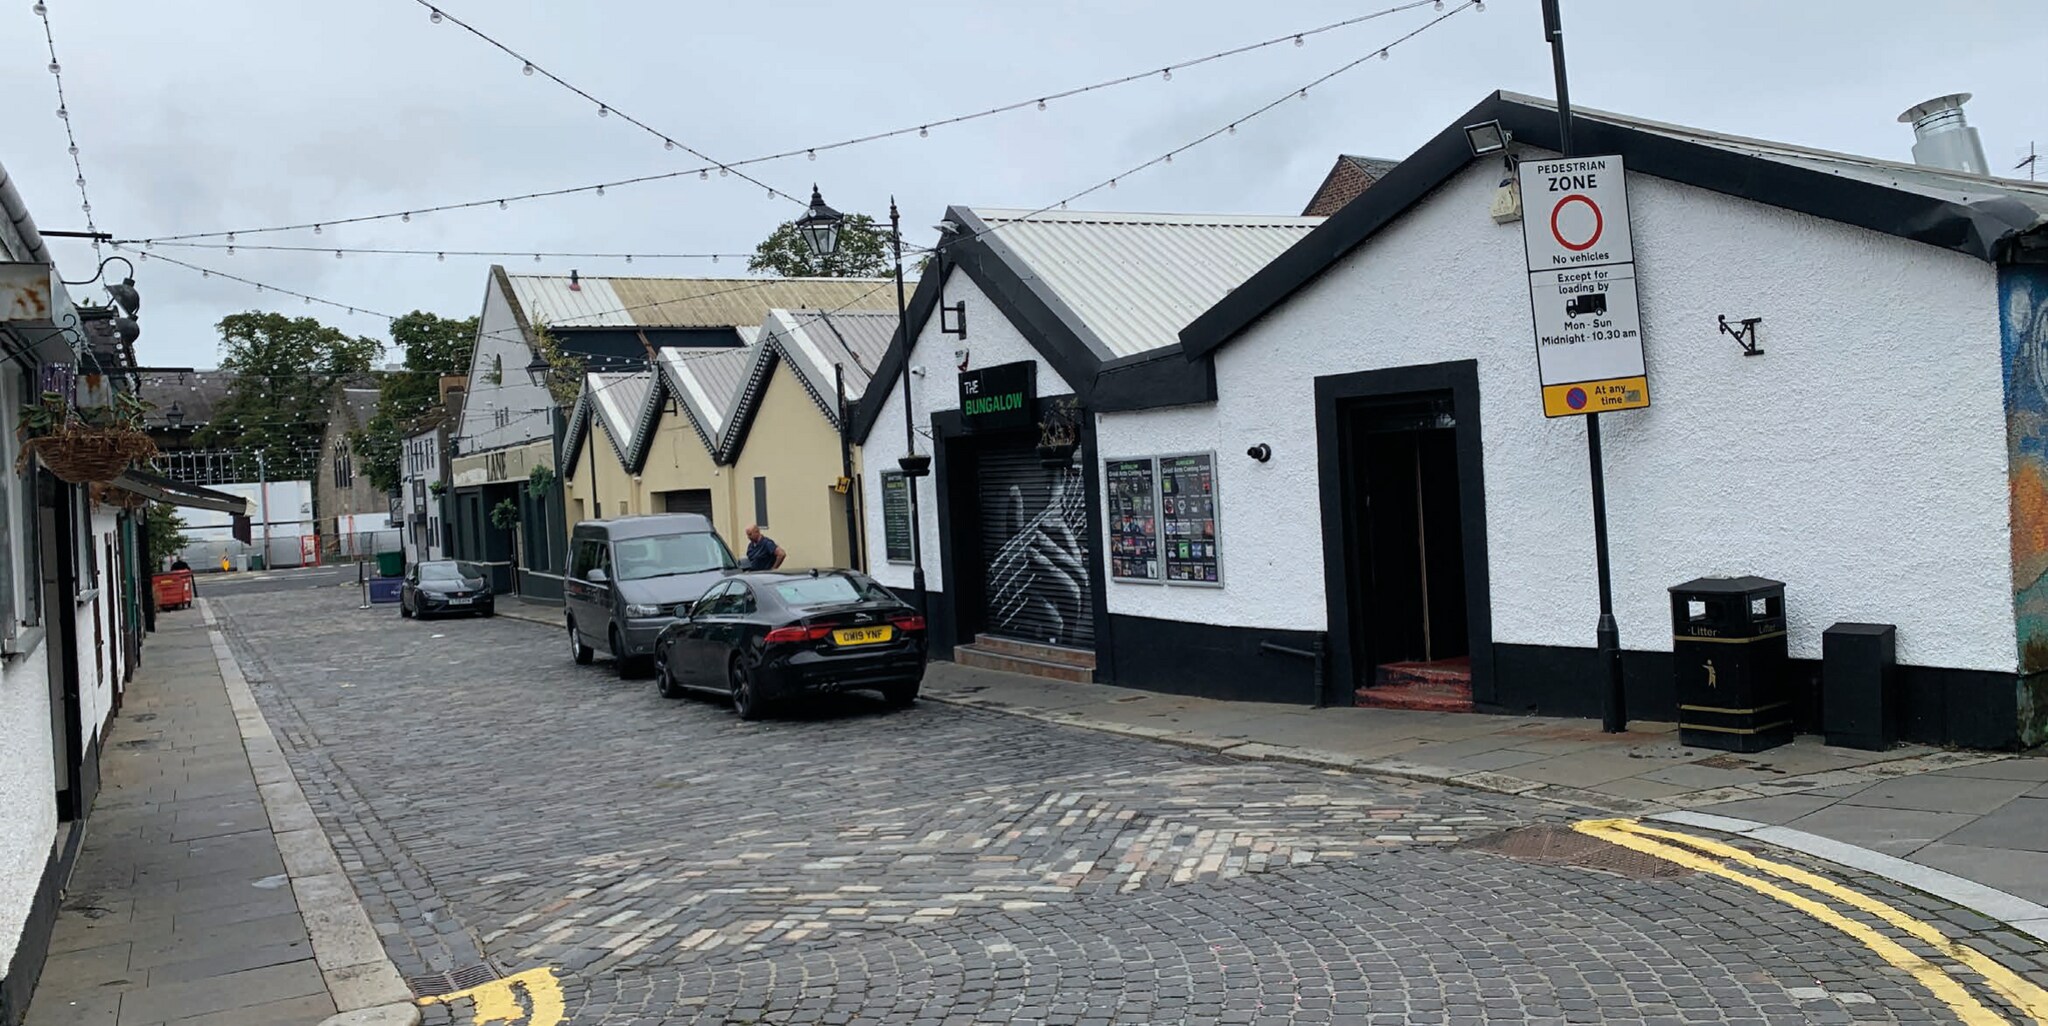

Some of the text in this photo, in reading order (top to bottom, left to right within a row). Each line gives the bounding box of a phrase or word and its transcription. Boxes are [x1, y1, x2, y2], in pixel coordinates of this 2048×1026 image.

[1537, 160, 1606, 174] PEDESTRIAN
[1548, 174, 1597, 192] ZONE
[1552, 252, 1609, 264] No vehicles
[1557, 270, 1608, 283] Except for
[1558, 281, 1609, 294] loading by
[1564, 321, 1585, 331] Mon
[1593, 319, 1612, 328] Sun
[1541, 333, 1585, 346] Midnight
[1592, 330, 1621, 341] 10.30
[1622, 330, 1637, 338] am
[964, 380, 979, 395] THE
[1595, 385, 1626, 395] At any
[965, 392, 1023, 416] BUNGALOW
[1601, 397, 1623, 406] time
[485, 451, 508, 482] LANE
[866, 629, 882, 639] YNF
[1691, 625, 1718, 637] Litter
